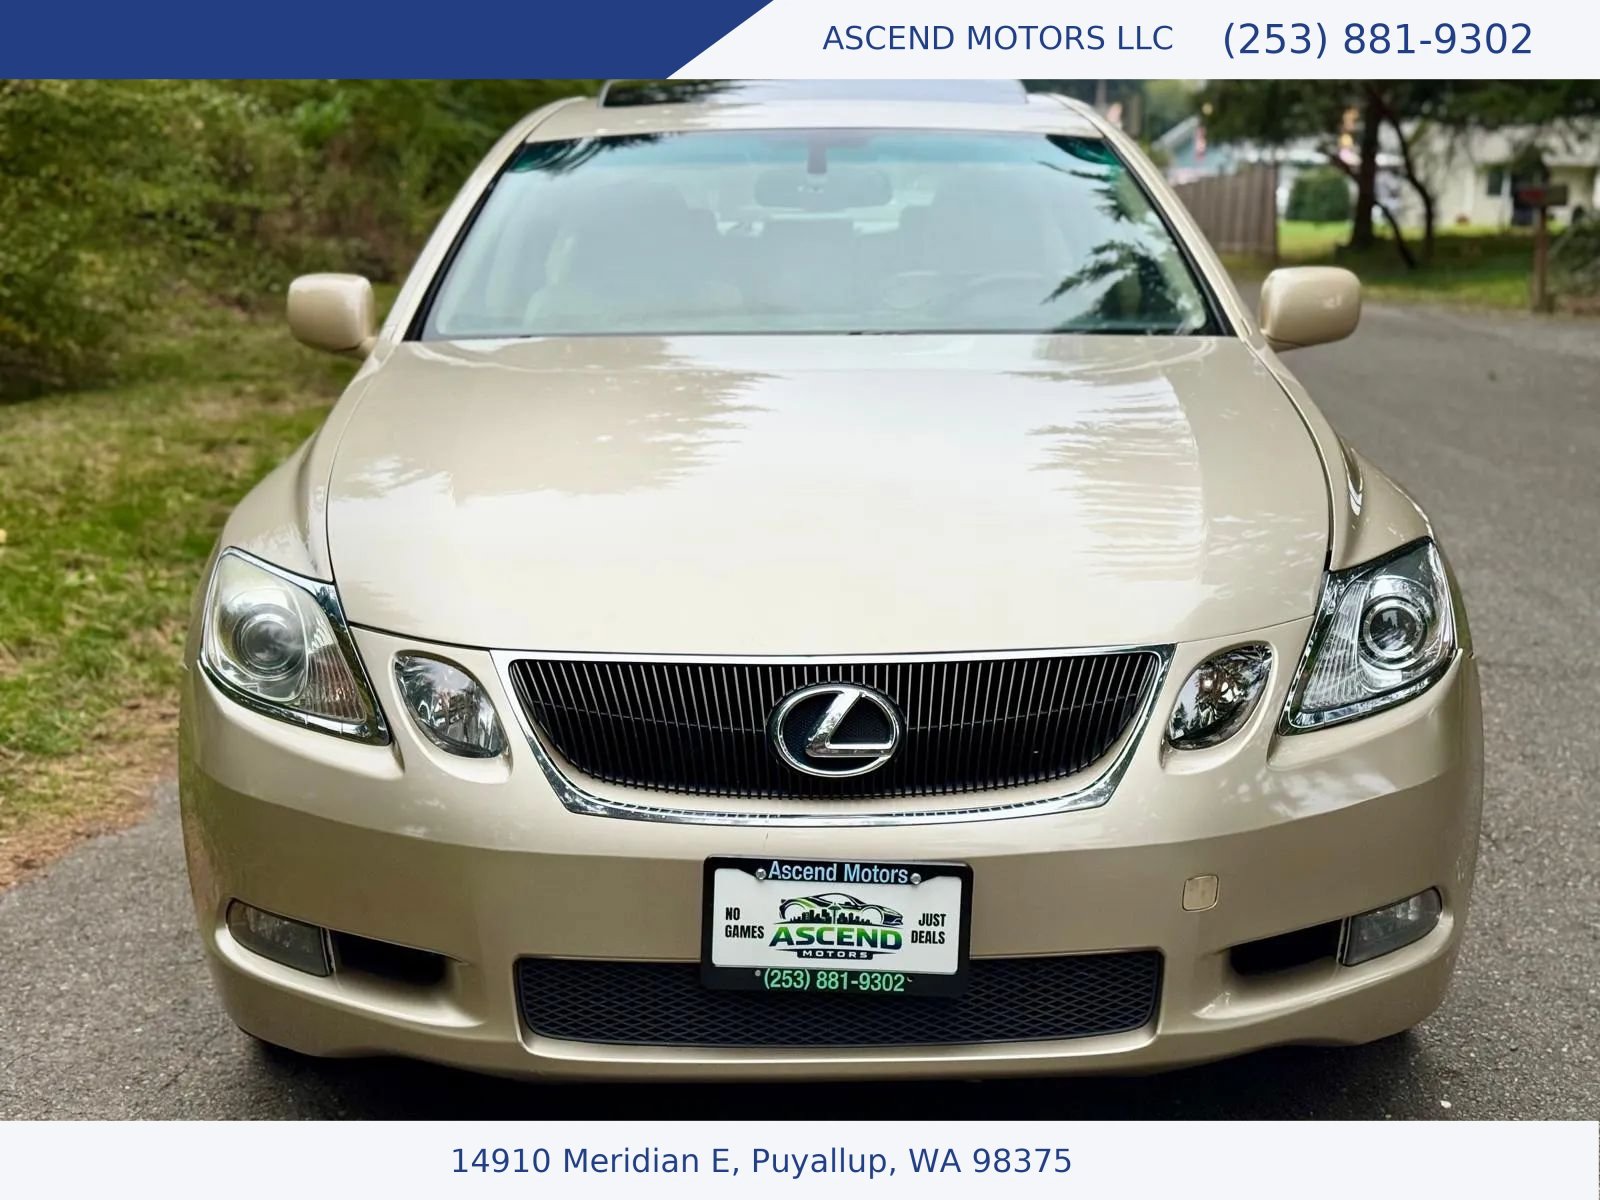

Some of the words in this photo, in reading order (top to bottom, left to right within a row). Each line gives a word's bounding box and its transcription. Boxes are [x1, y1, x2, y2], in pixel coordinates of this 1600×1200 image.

[768, 861, 837, 882] Ascend
[844, 863, 909, 884] Motors
[725, 907, 740, 921] NO
[918, 913, 947, 928] JUST
[725, 924, 765, 939] GAMES
[768, 926, 903, 950] ASCEND
[911, 930, 946, 944] DEALS
[802, 950, 869, 959] MOTORS
[764, 968, 811, 990] (253)
[816, 970, 906, 992] 881-9302
